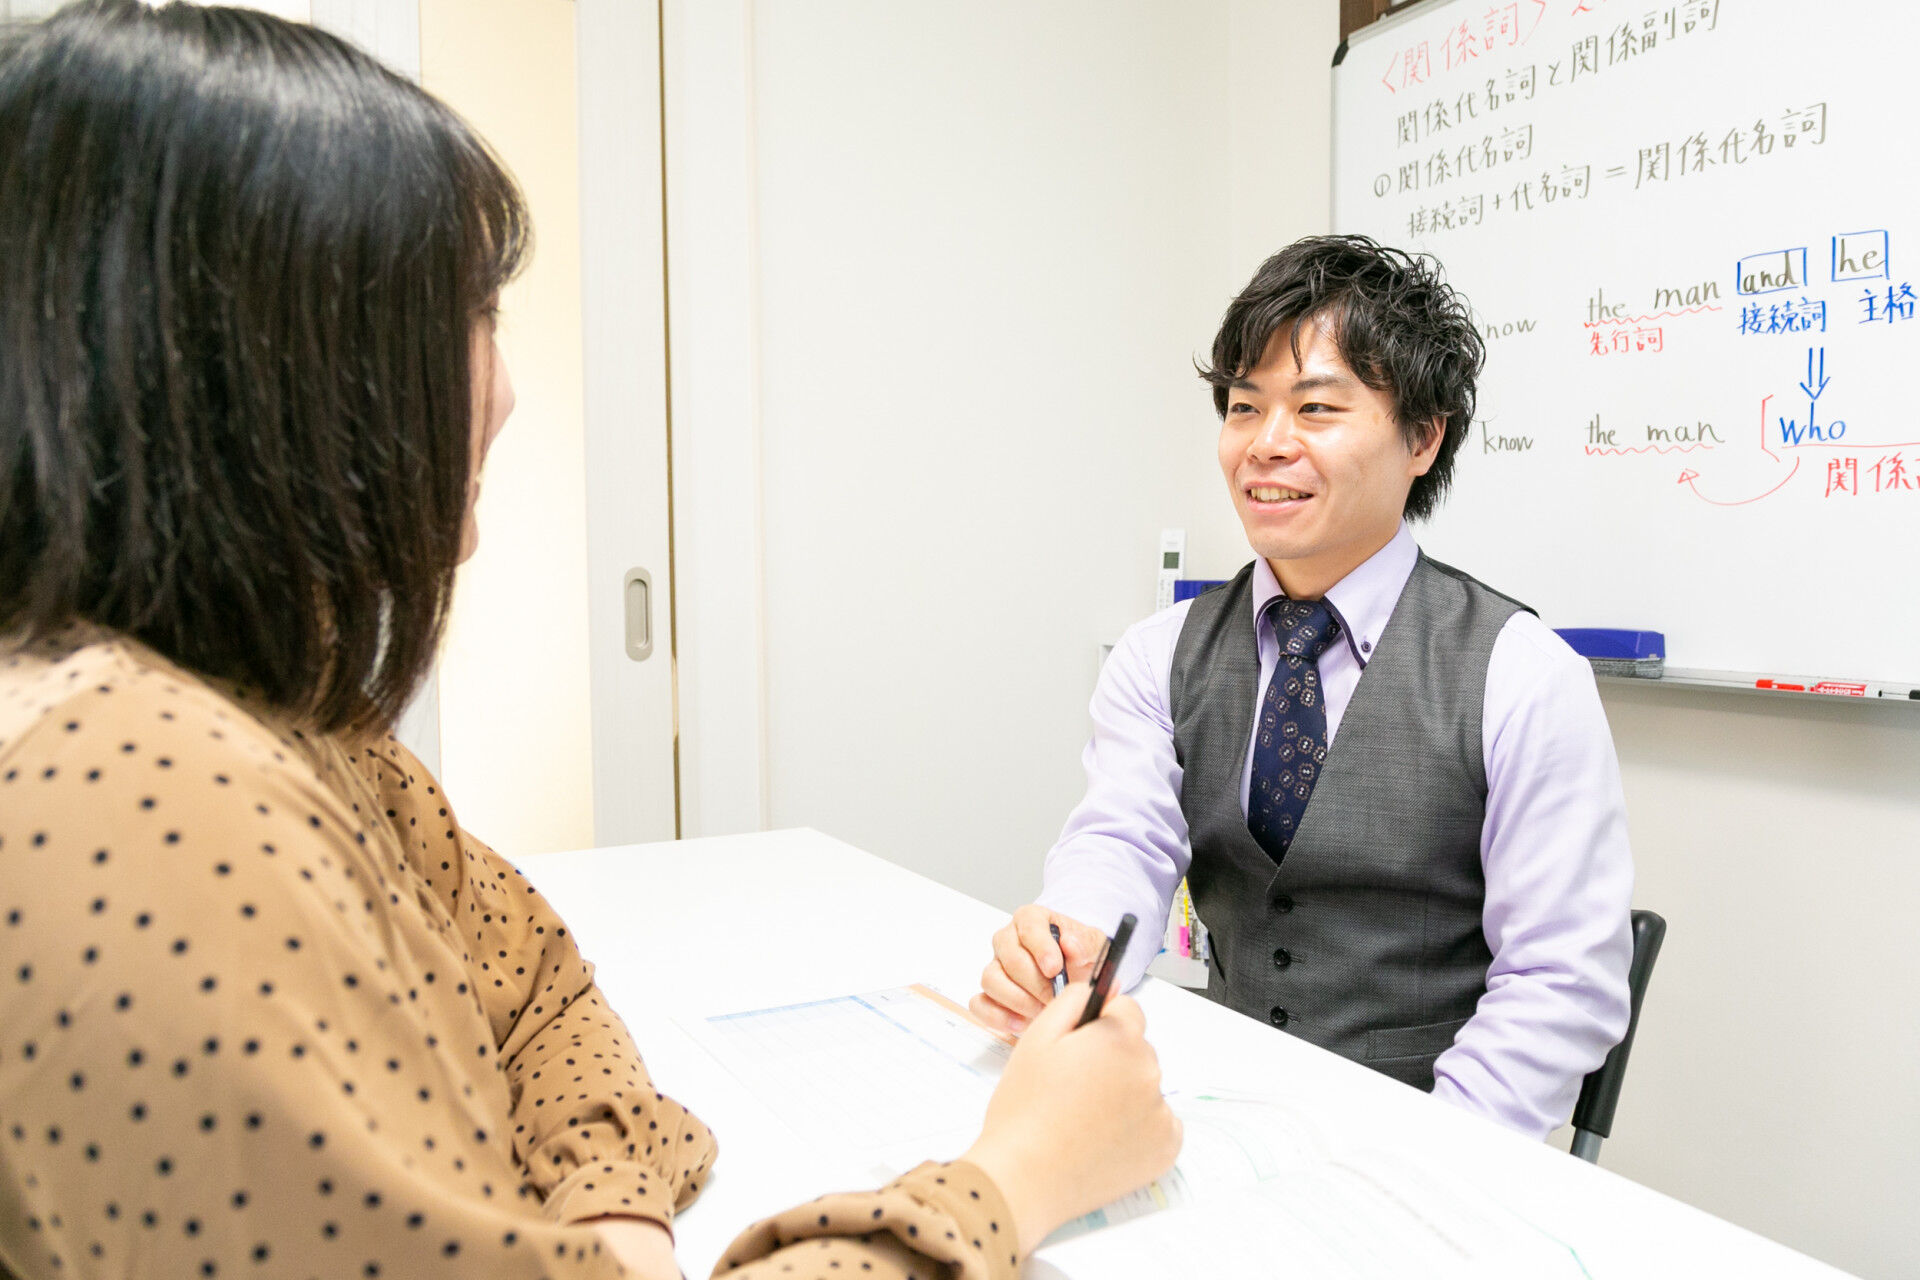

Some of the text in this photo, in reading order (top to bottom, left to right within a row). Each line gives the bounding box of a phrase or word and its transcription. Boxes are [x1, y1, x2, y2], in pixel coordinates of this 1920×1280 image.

[1585, 288, 1630, 323] the
[1654, 281, 1721, 310] man
[1743, 250, 1800, 293] and
[1839, 238, 1886, 273] he
[1858, 281, 1918, 325] 主格
[1736, 296, 1827, 336] 接続詞
[1590, 326, 1664, 356] 先行詞
[1483, 401, 1847, 455] know the man who
[1825, 452, 1920, 498] 関係
